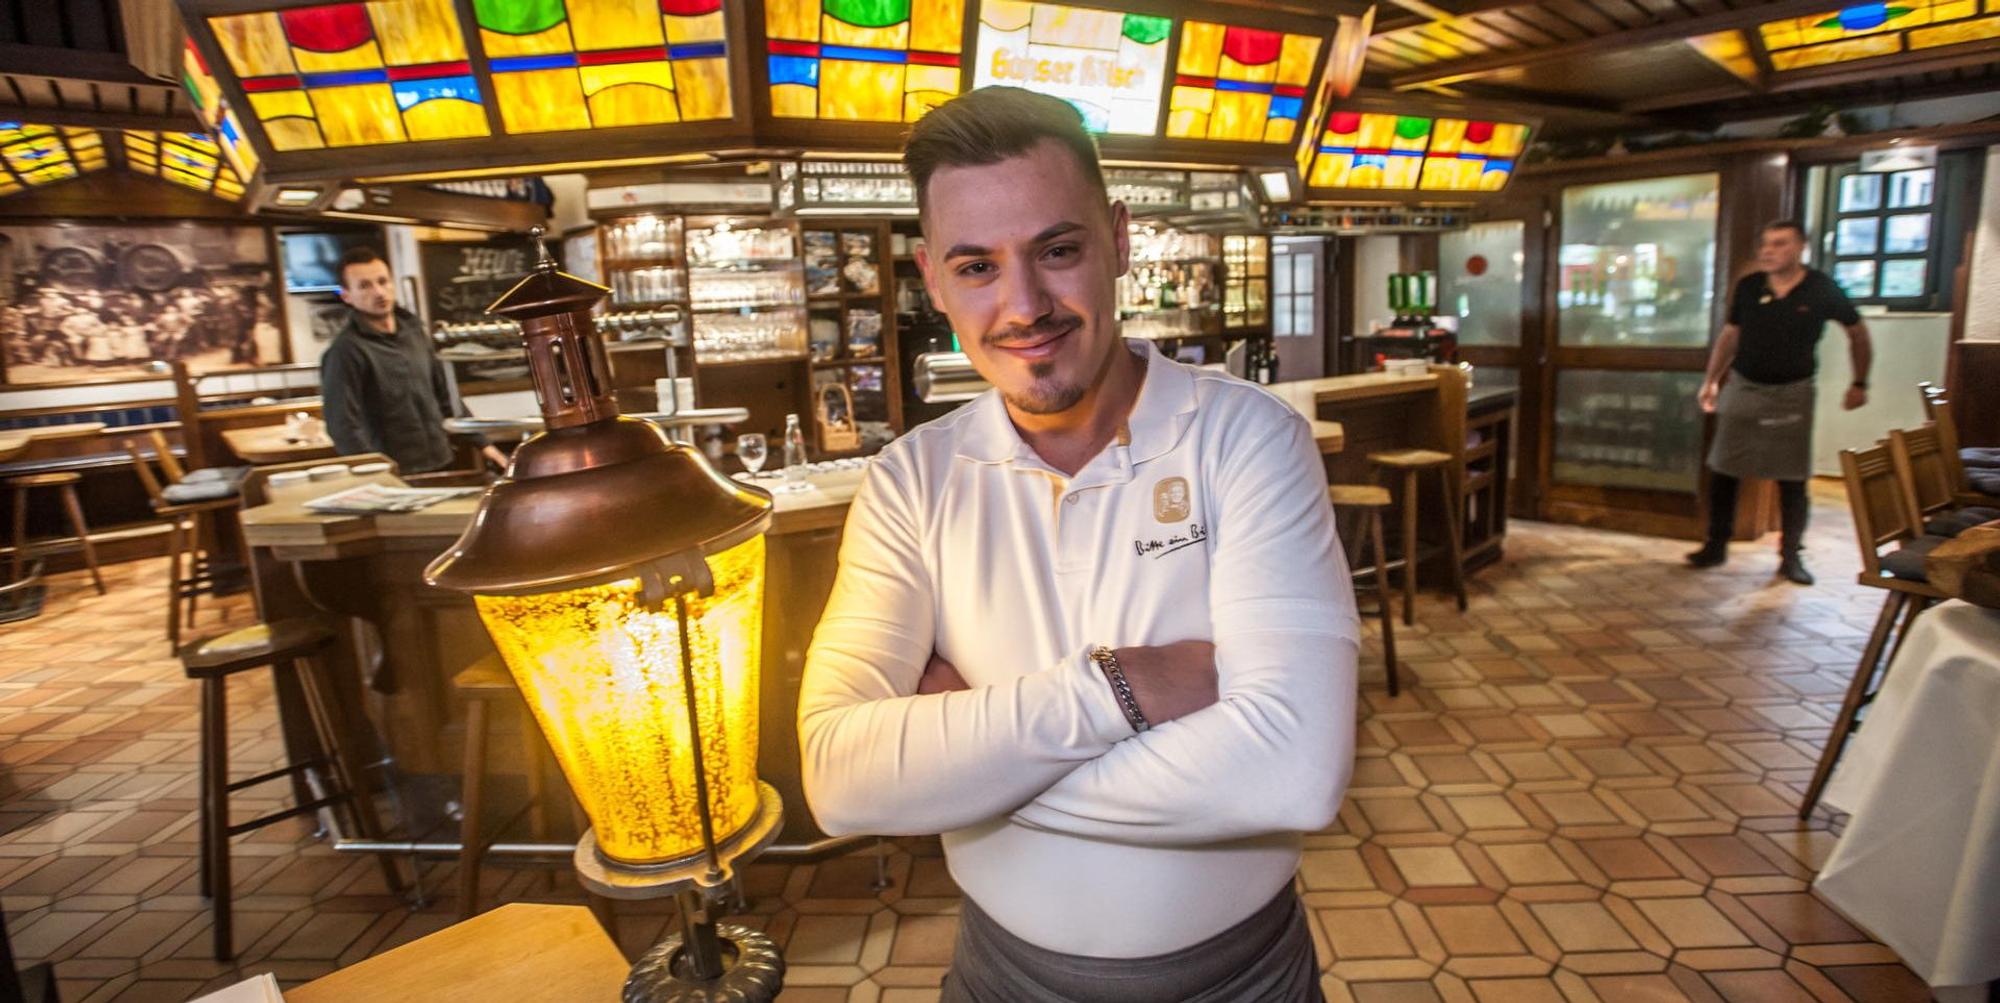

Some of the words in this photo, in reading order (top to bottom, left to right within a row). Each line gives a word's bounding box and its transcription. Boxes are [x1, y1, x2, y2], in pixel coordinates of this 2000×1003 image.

[1135, 540, 1165, 556] Bitte
[1169, 535, 1189, 545] ein
[1190, 524, 1207, 539] Bi
